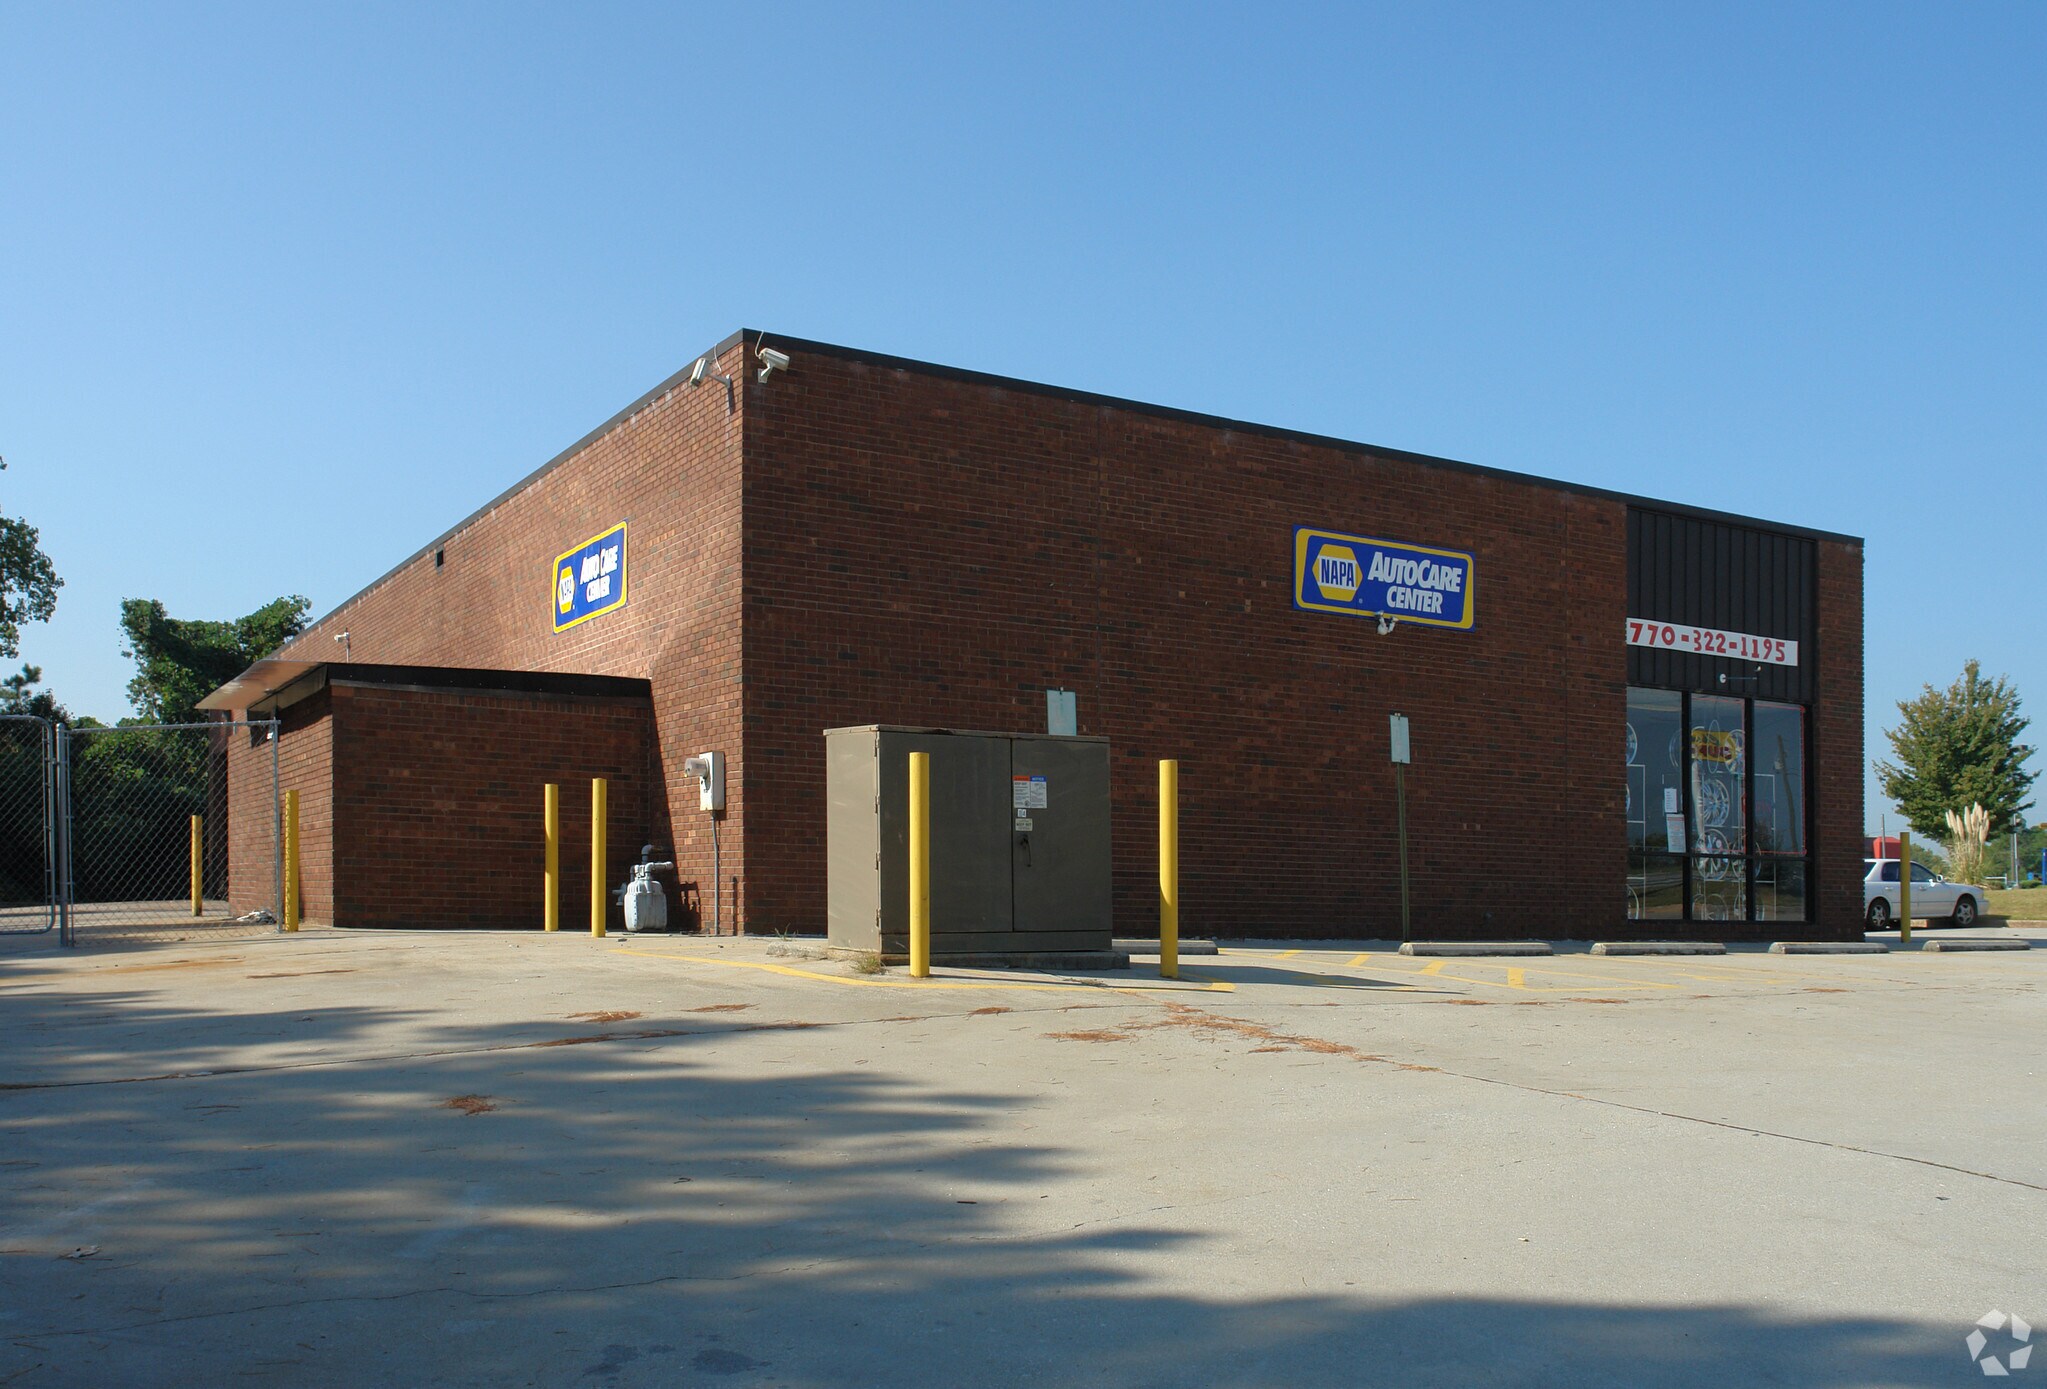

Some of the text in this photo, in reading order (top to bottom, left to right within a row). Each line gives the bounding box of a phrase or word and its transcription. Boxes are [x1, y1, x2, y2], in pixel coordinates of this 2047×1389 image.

[1320, 558, 1355, 588] NAPA
[1386, 585, 1443, 614] CENTER
[1629, 621, 1786, 662] 770-322-1195
